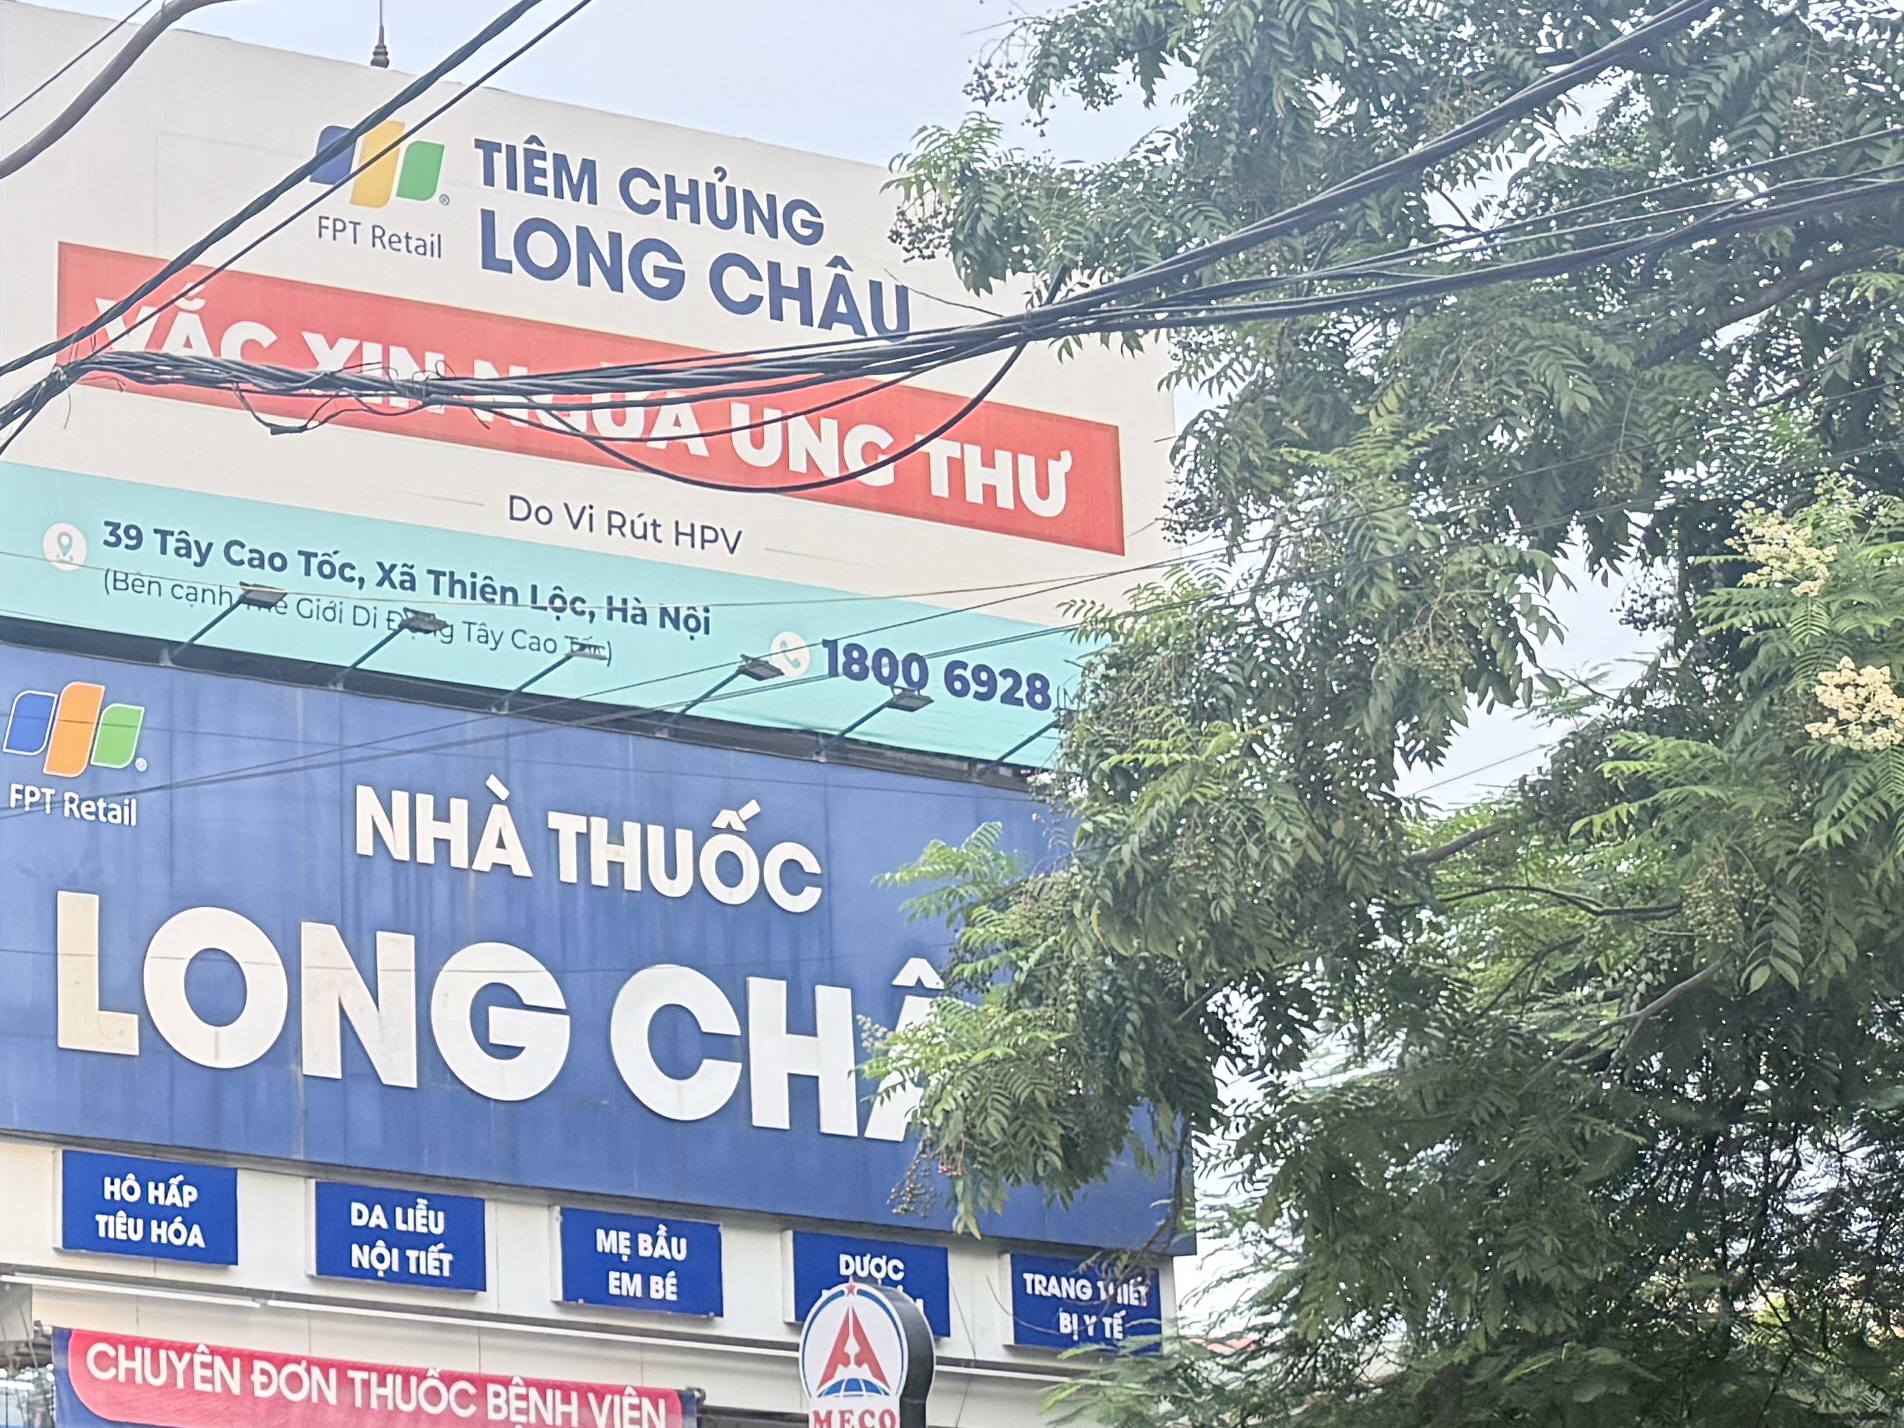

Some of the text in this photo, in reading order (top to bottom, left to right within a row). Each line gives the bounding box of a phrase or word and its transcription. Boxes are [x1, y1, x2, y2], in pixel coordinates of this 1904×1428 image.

[475, 134, 825, 247] TIÊM CHỦNG
[318, 215, 442, 260] FPT Retail
[480, 207, 911, 341] LONG CHÂU
[915, 433, 1072, 518] THƯ
[509, 494, 743, 556] Do Vi Rút HPV
[103, 520, 711, 642] 39 Tây Cao Tốc, Xã Thiên Lộc, Hà Nội
[104, 569, 161, 599] (Bên
[170, 581, 234, 612] cạnh
[297, 595, 344, 625] Giới
[353, 605, 378, 630] Di
[462, 621, 503, 654] Tây
[511, 628, 558, 656] Cao
[822, 638, 929, 692] 1800
[944, 659, 1052, 711] 6928
[9, 783, 137, 828] FPT Retail
[356, 773, 823, 914] NHÀ THUỐC
[56, 890, 571, 1103] LONG
[104, 1174, 198, 1208] HÔ HẤP
[96, 1213, 205, 1249] TIÊU HÓA
[351, 1197, 444, 1235] DA LIỄU
[351, 1241, 452, 1278] NỘI TIẾT
[595, 1223, 687, 1261] MẸ BẦU
[609, 1269, 678, 1300] EM BÉ
[839, 1254, 905, 1284] DƯỢC
[1023, 1273, 1092, 1301] TRANG
[1059, 1309, 1126, 1341] BỊ Y TẾ
[87, 1342, 241, 1396] CHUYÊN
[252, 1359, 337, 1406] ĐƠN
[347, 1368, 476, 1419] THUỐC
